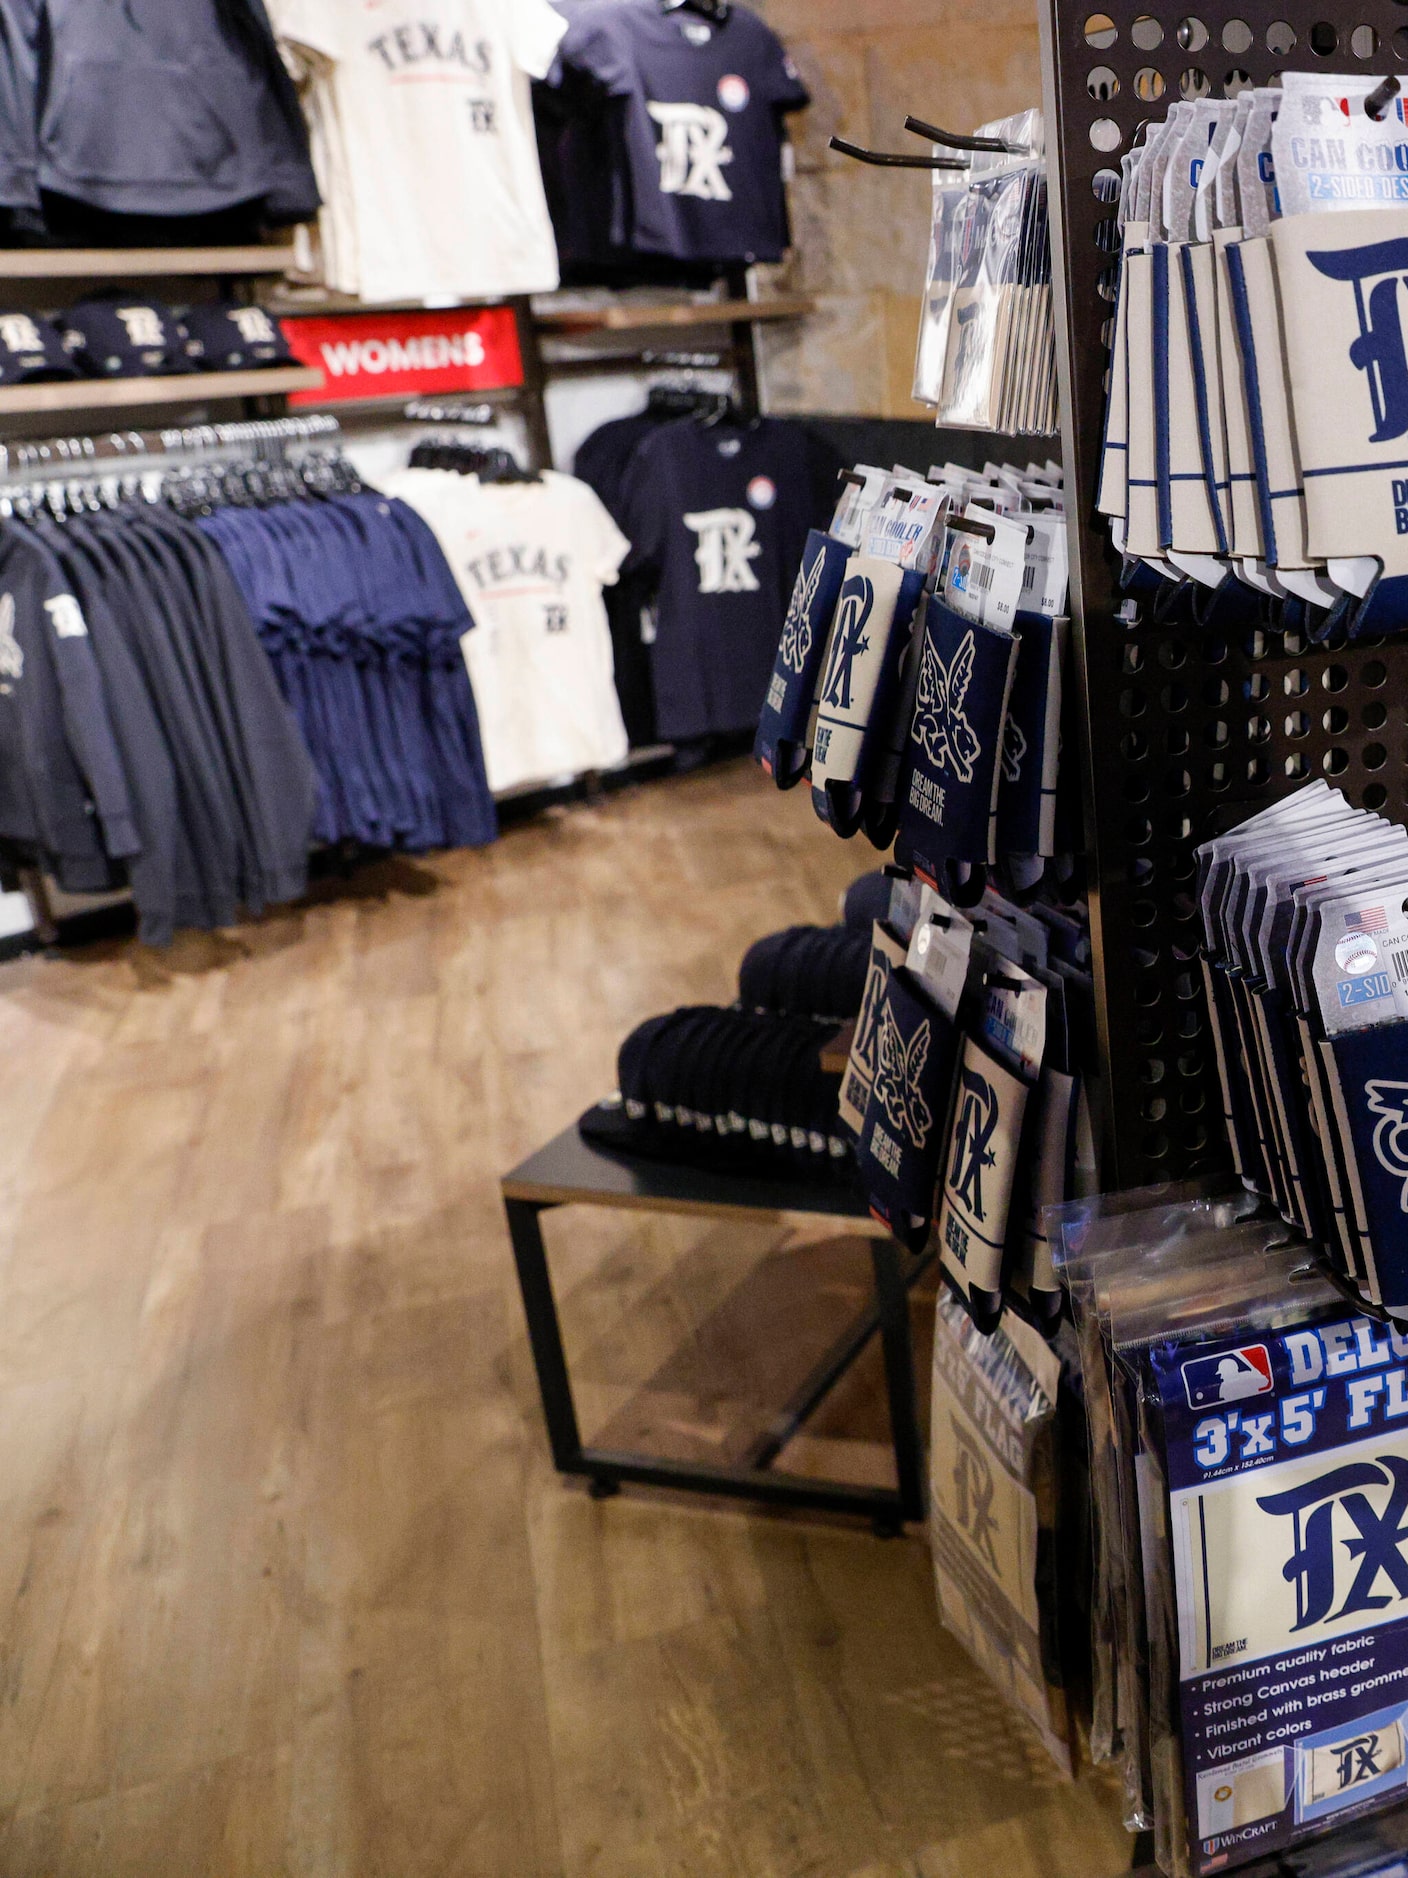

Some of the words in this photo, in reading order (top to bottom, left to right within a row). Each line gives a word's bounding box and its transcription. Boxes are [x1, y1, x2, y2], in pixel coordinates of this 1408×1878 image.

[368, 20, 492, 74] TEXAS
[1290, 136, 1346, 170] CAN
[1311, 174, 1375, 199] 2-SIDED
[319, 331, 486, 377] WOMENS
[1382, 936, 1400, 948] CAN
[1202, 1466, 1233, 1480] 91.44cm
[1202, 1664, 1271, 1692] Premium
[1275, 1648, 1327, 1673] quality
[1331, 1635, 1376, 1656] fabric
[1203, 1692, 1253, 1716] Strong
[1257, 1675, 1316, 1700] Canvas
[1320, 1657, 1376, 1681] header
[1205, 1708, 1268, 1739] Finished
[1272, 1697, 1303, 1718] with
[1306, 1686, 1347, 1707] brass
[1207, 1733, 1262, 1760] Vibrant
[1265, 1718, 1313, 1742] colors
